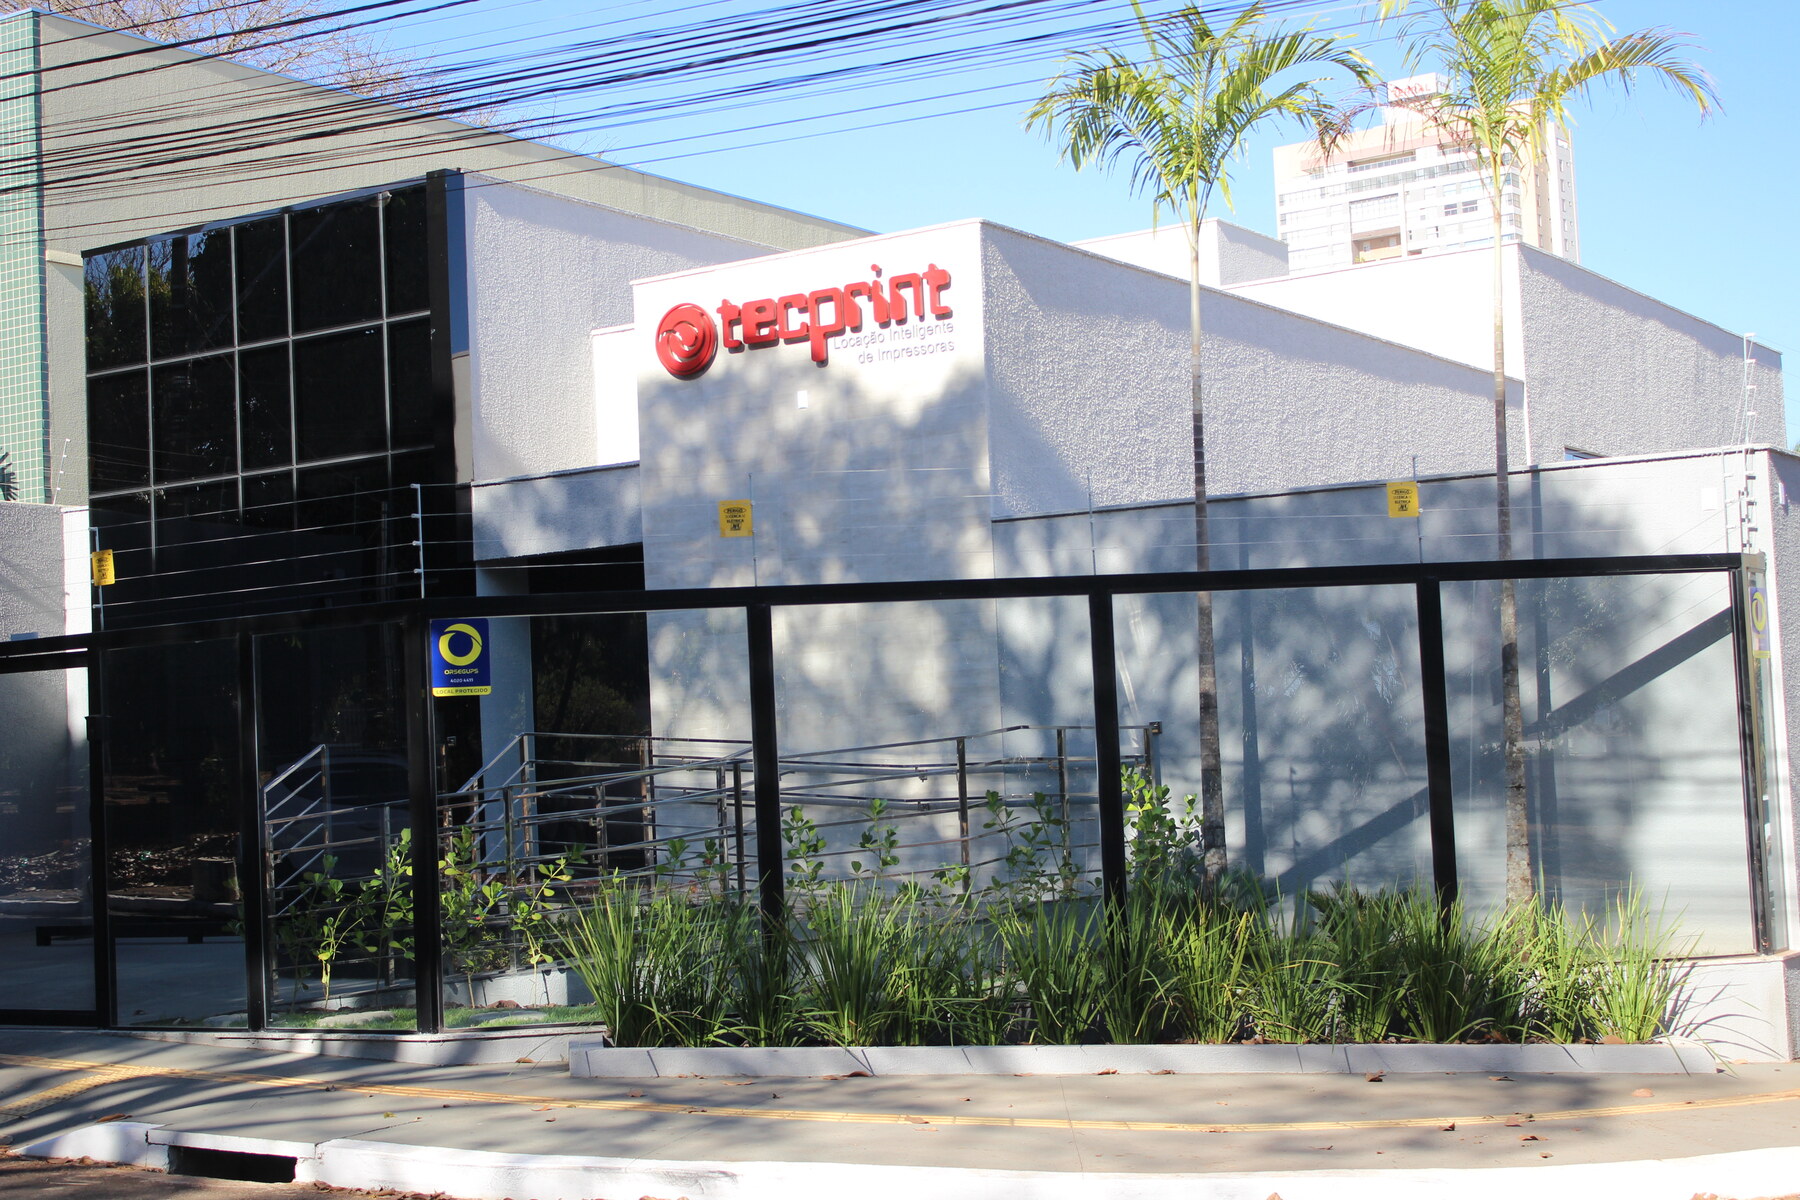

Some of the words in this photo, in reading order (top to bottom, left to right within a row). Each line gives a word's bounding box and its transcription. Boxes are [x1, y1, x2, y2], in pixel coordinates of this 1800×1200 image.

[716, 263, 953, 367] tecprint
[833, 331, 885, 350] Locação
[889, 322, 954, 341] Inteligente
[858, 351, 874, 365] de
[878, 341, 955, 363] Impressoras
